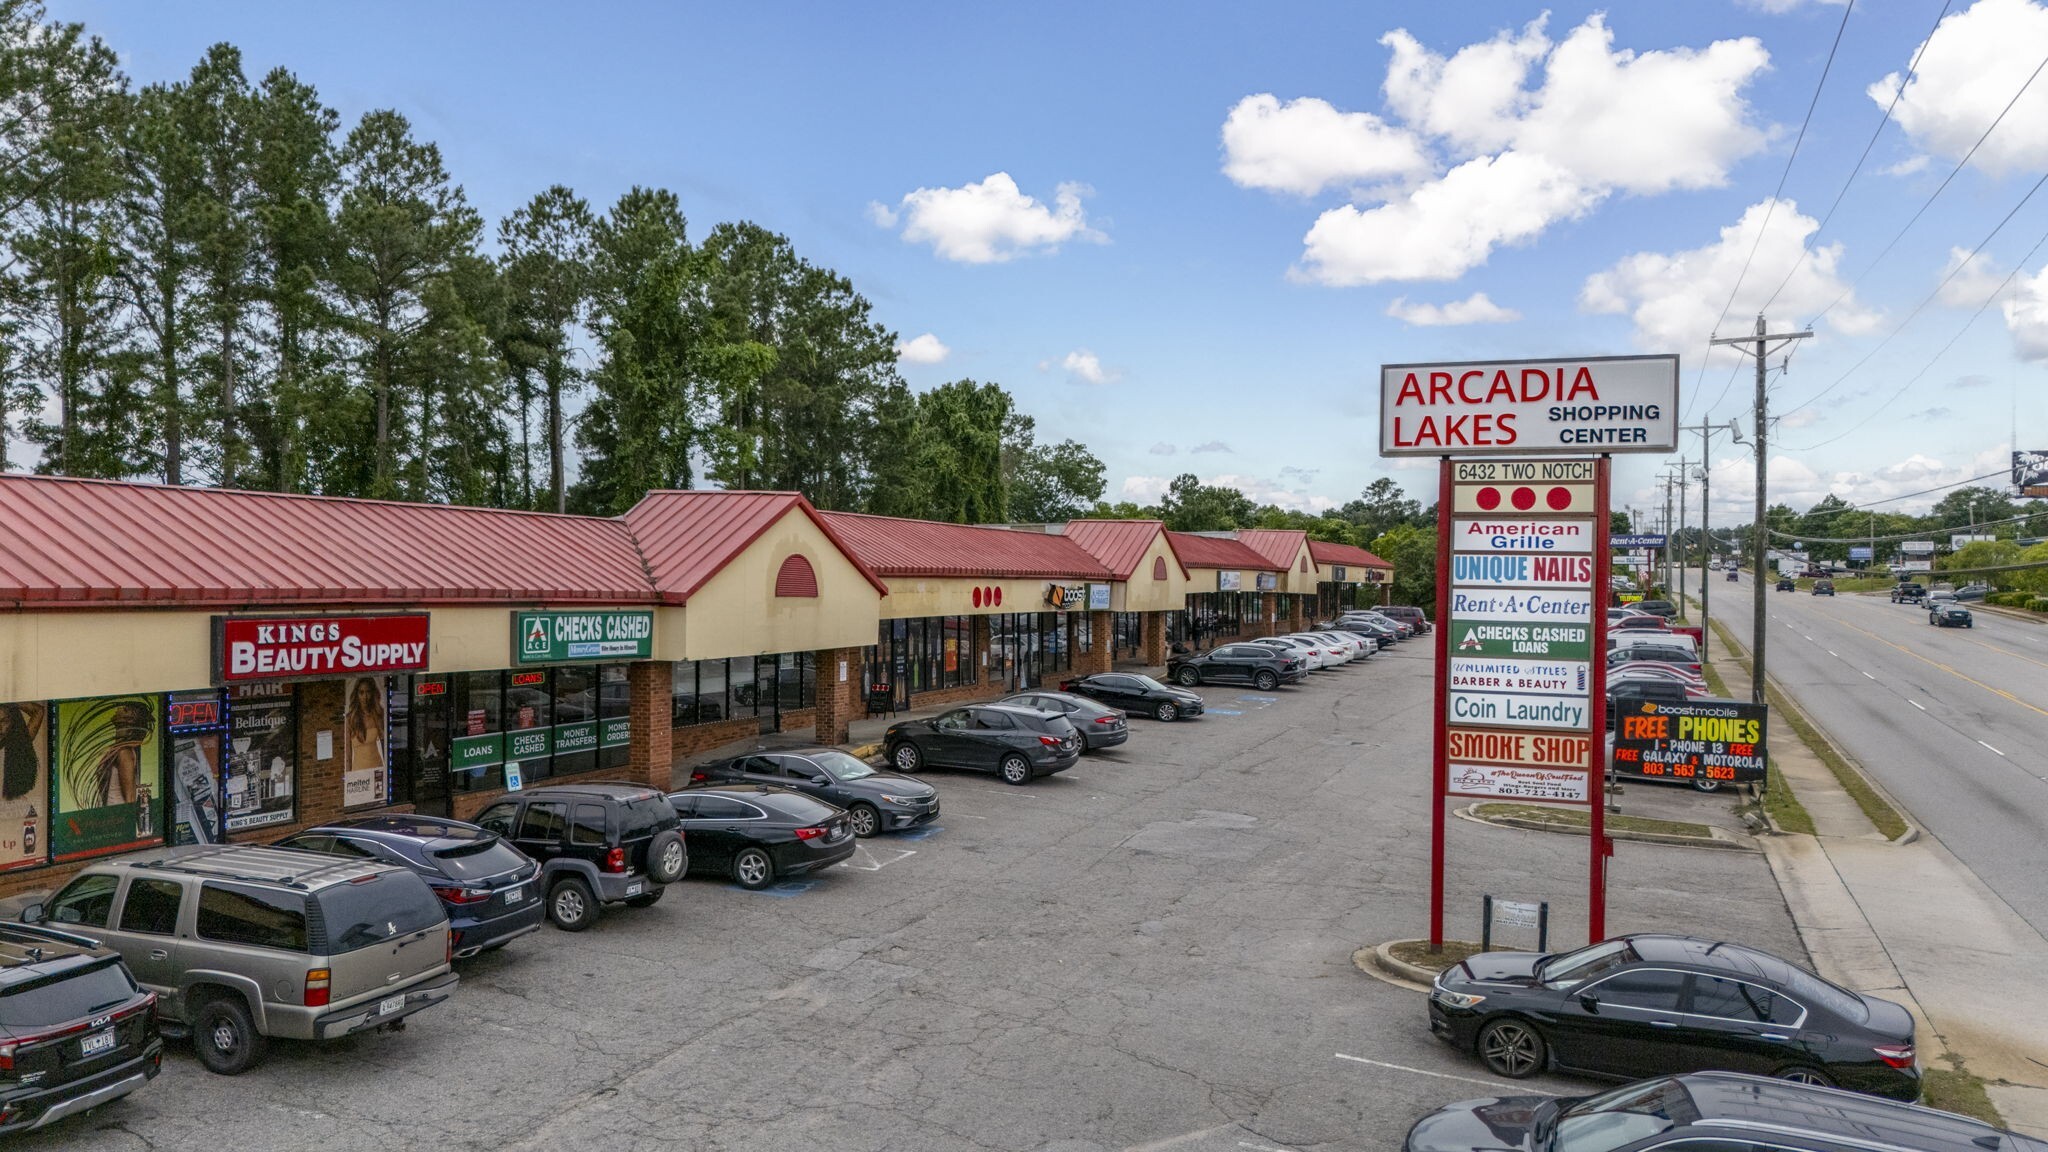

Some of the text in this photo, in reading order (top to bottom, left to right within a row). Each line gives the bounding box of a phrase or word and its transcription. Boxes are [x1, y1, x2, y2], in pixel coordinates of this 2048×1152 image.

[1395, 366, 1600, 407] ARCADIA
[1548, 404, 1661, 422] SHOPPING
[1393, 413, 1518, 448] LAKES
[1559, 427, 1647, 444] CENTER
[1458, 462, 1593, 480] 6432 TWO NOTCH
[1467, 522, 1580, 536] American
[1491, 535, 1555, 549] Grille
[1454, 555, 1591, 584] UNIQUE NAILS
[257, 623, 341, 645] KINGS
[554, 616, 650, 642] CHECKS CASHED
[1477, 625, 1529, 641] CHECKS
[1532, 627, 1586, 643] CASHED
[1512, 641, 1549, 654] LOANS
[231, 635, 426, 675] BEAUTY SUPPLY
[513, 673, 543, 685] LOANS
[1453, 676, 1568, 690] BARBER & BEAUTY
[416, 683, 444, 696] OPEN
[170, 703, 218, 725] OPEN
[1454, 696, 1583, 727] Coin Laundry
[235, 715, 287, 729] Bellatique
[607, 722, 632, 732] MONEY
[563, 727, 590, 739] MONEY
[1623, 715, 1760, 744] FREE PHONES
[513, 733, 546, 746] CHECKS
[554, 735, 597, 749] TRANSFERS
[463, 745, 493, 758] LOANS
[513, 743, 546, 756] CASHED
[1450, 732, 1590, 764] SMOKE SHOP
[1712, 742, 1724, 754] 13
[1729, 743, 1755, 756] FREE
[1615, 749, 1764, 769] FREE GALAXY & MOTOROLA
[346, 779, 371, 789] melted
[1498, 787, 1581, 799] 803-722-4147
[248, 814, 269, 825] BEAUTY
[269, 811, 289, 821] SUPPLY
